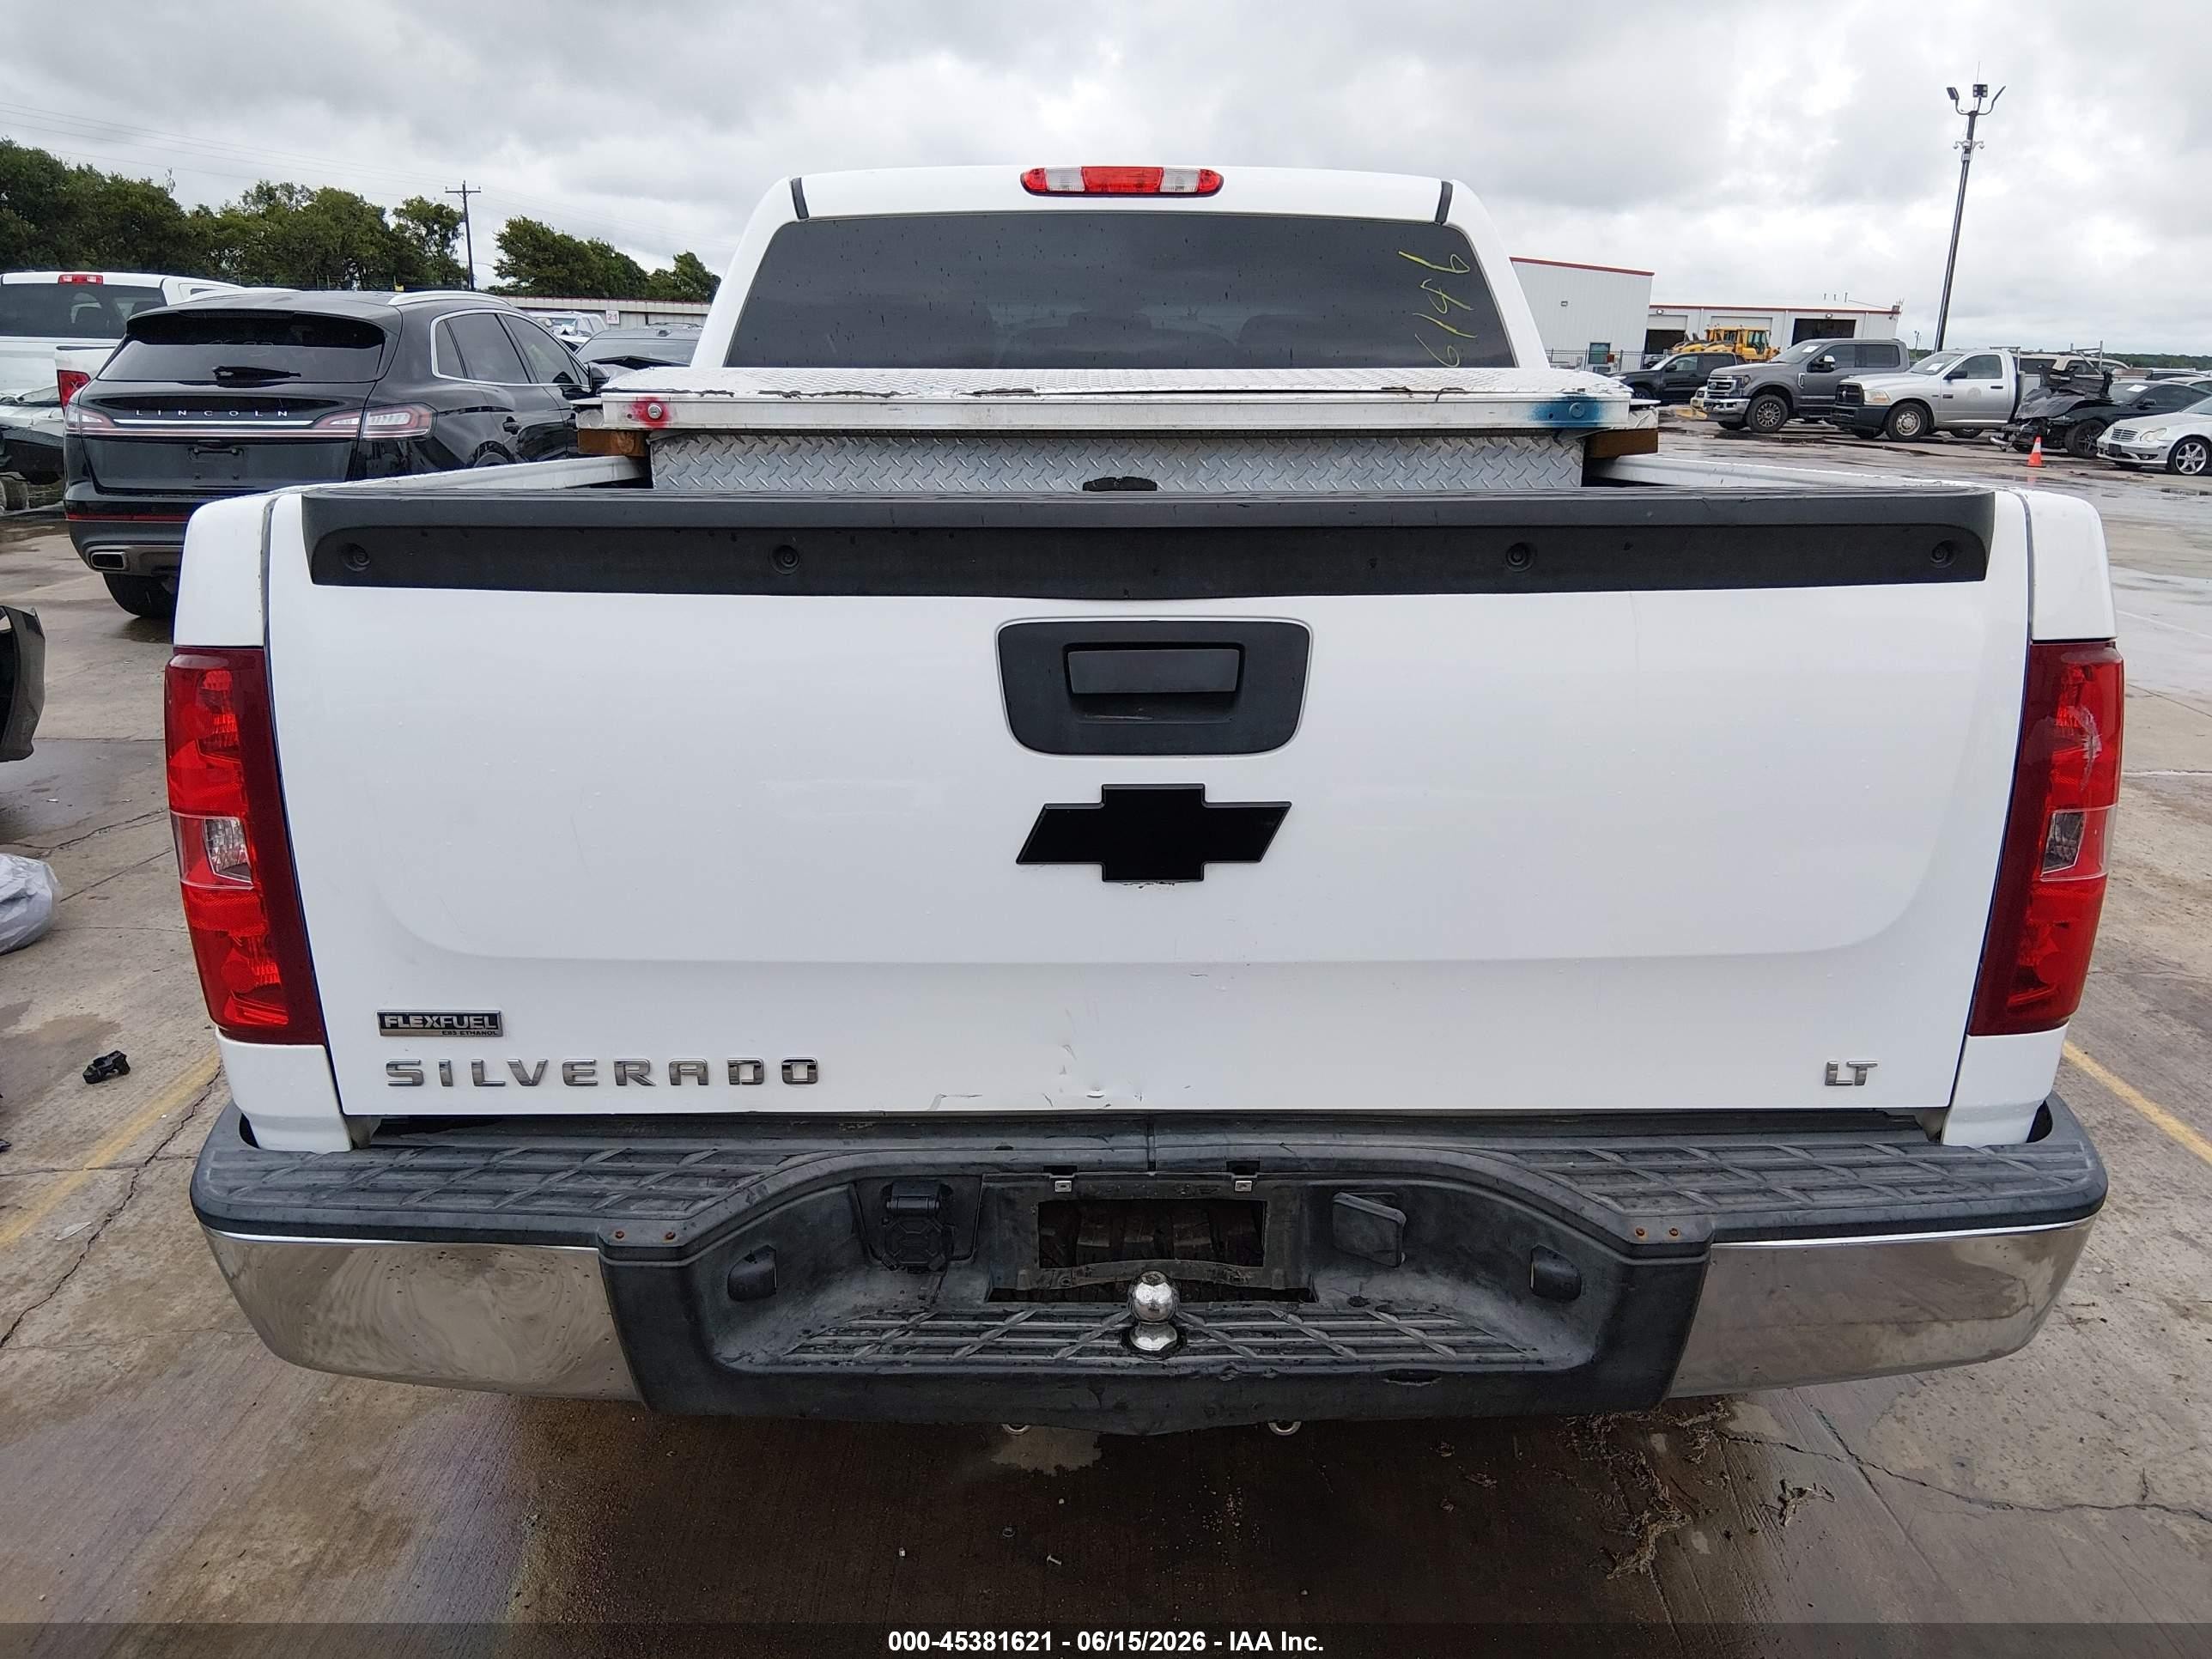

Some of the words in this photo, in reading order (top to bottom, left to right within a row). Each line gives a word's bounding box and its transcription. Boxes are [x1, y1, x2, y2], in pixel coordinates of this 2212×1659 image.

[136, 409, 289, 417] LINCOLN
[384, 1015, 497, 1029] FLEXFUEL
[386, 1057, 819, 1087] SILVERADO
[1825, 1060, 1878, 1085] LT
